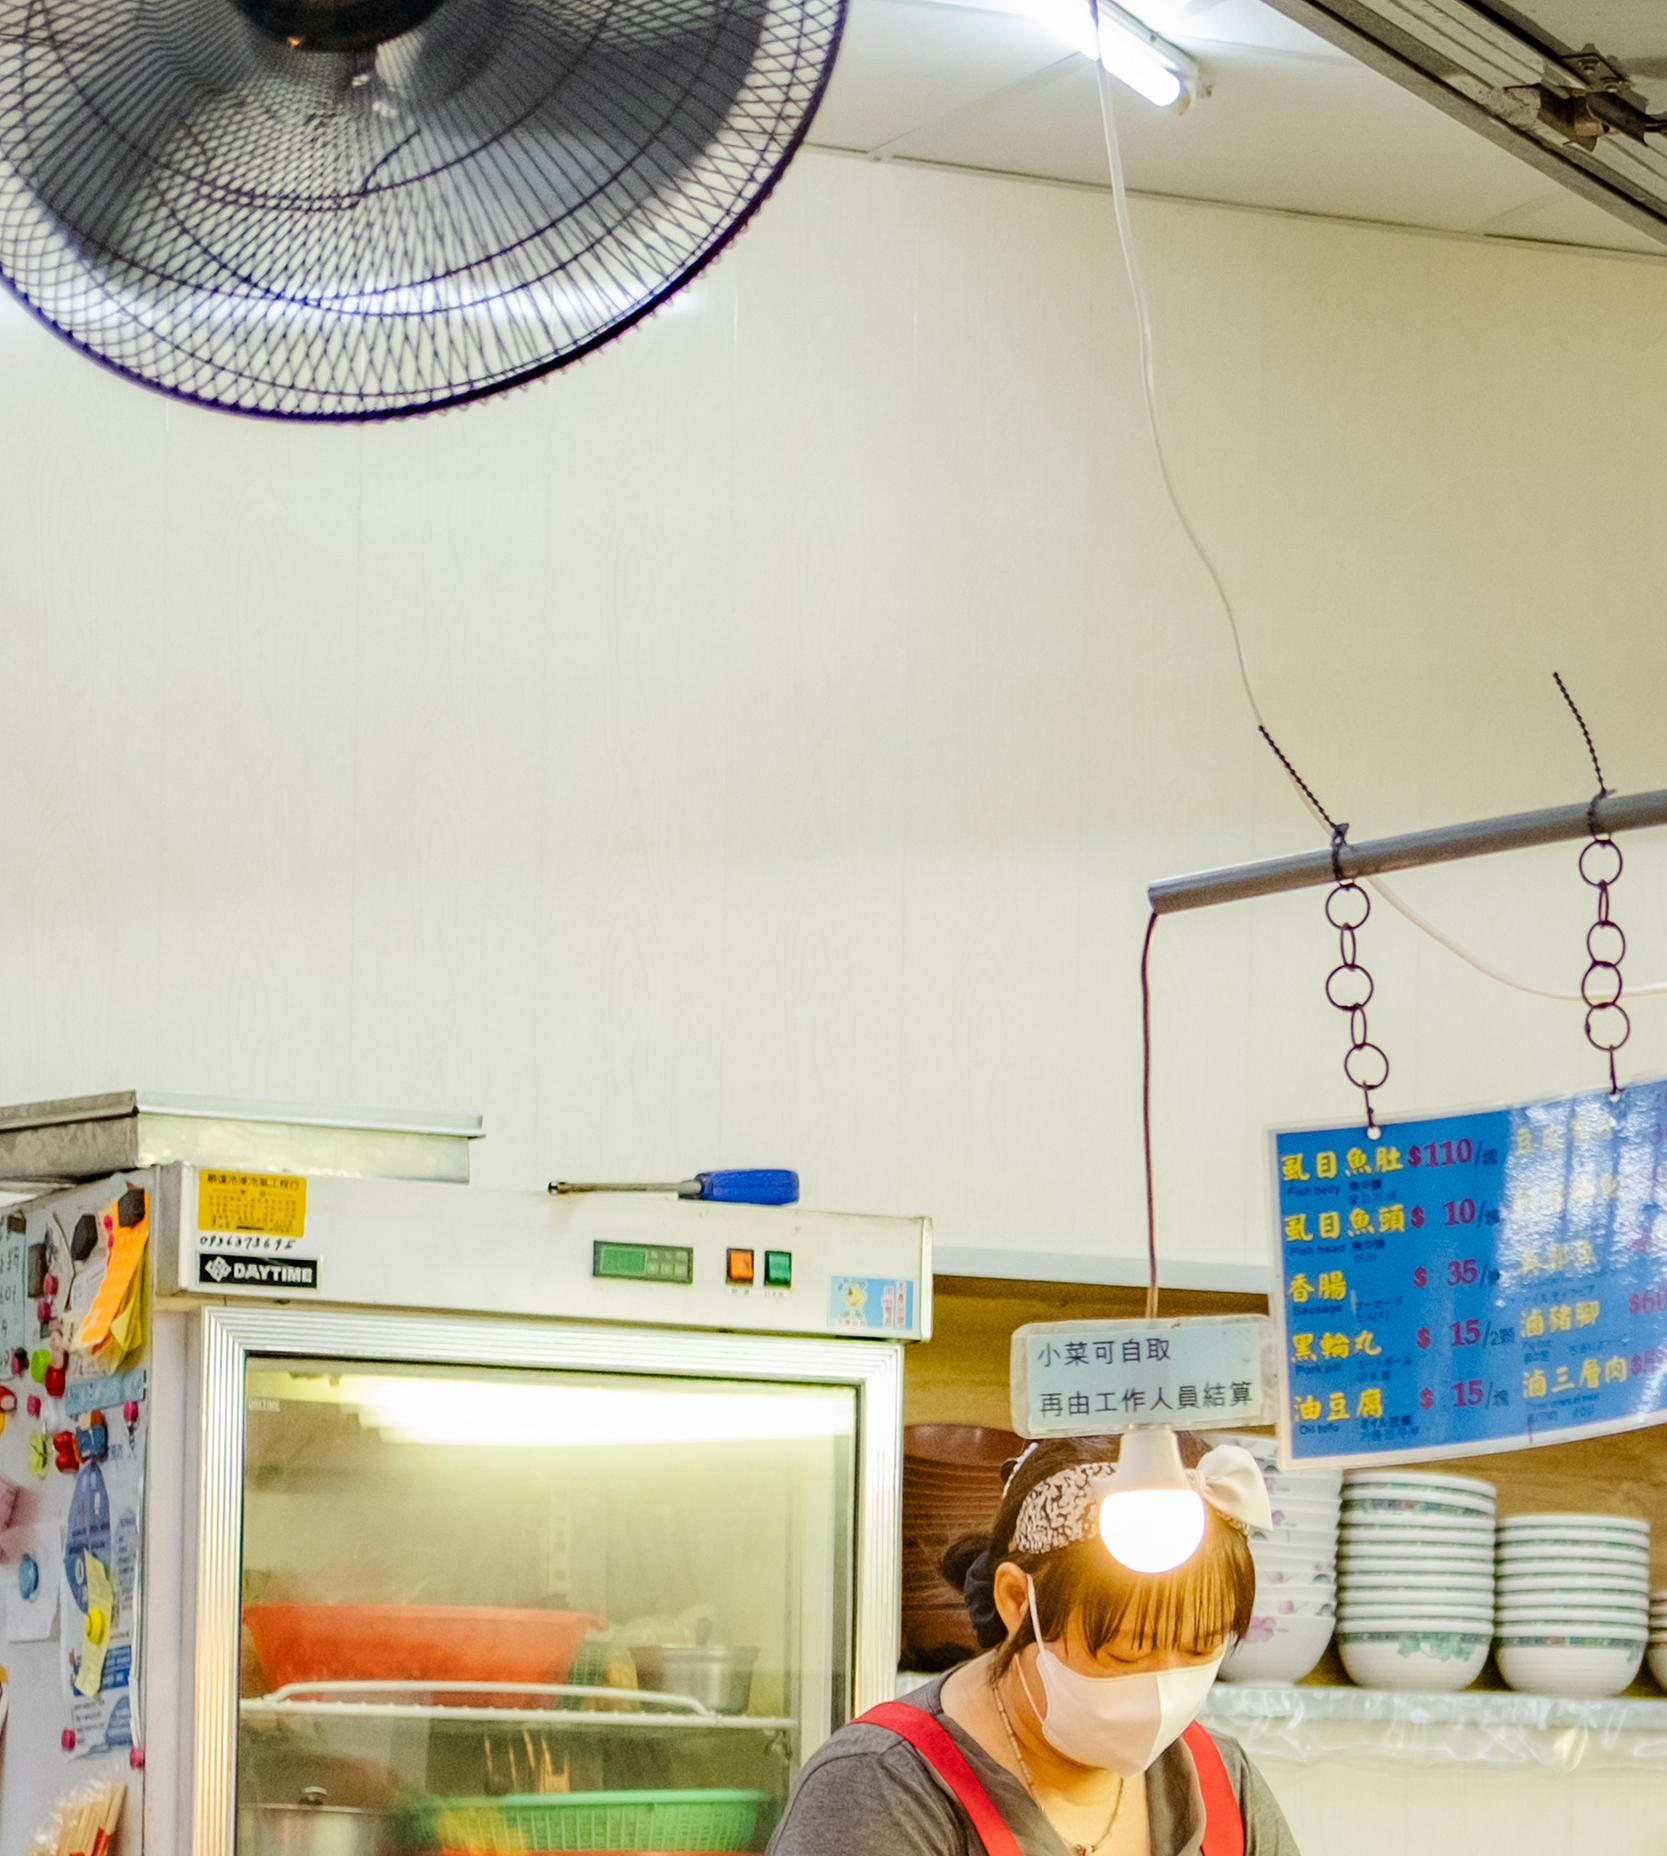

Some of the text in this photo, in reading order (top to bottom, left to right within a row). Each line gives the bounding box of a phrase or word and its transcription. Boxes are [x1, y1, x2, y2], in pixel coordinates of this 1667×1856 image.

[1285, 1204, 1405, 1241] 虱目魚頭
[233, 1262, 313, 1284] DAYTIME
[1289, 1271, 1347, 1303] 香腸
[1037, 1337, 1172, 1368] 小菜可自取
[1291, 1330, 1382, 1363] 黑輪丸
[1040, 1381, 1253, 1417] 再由工作人員結算
[1293, 1388, 1383, 1422] 油豆腐
